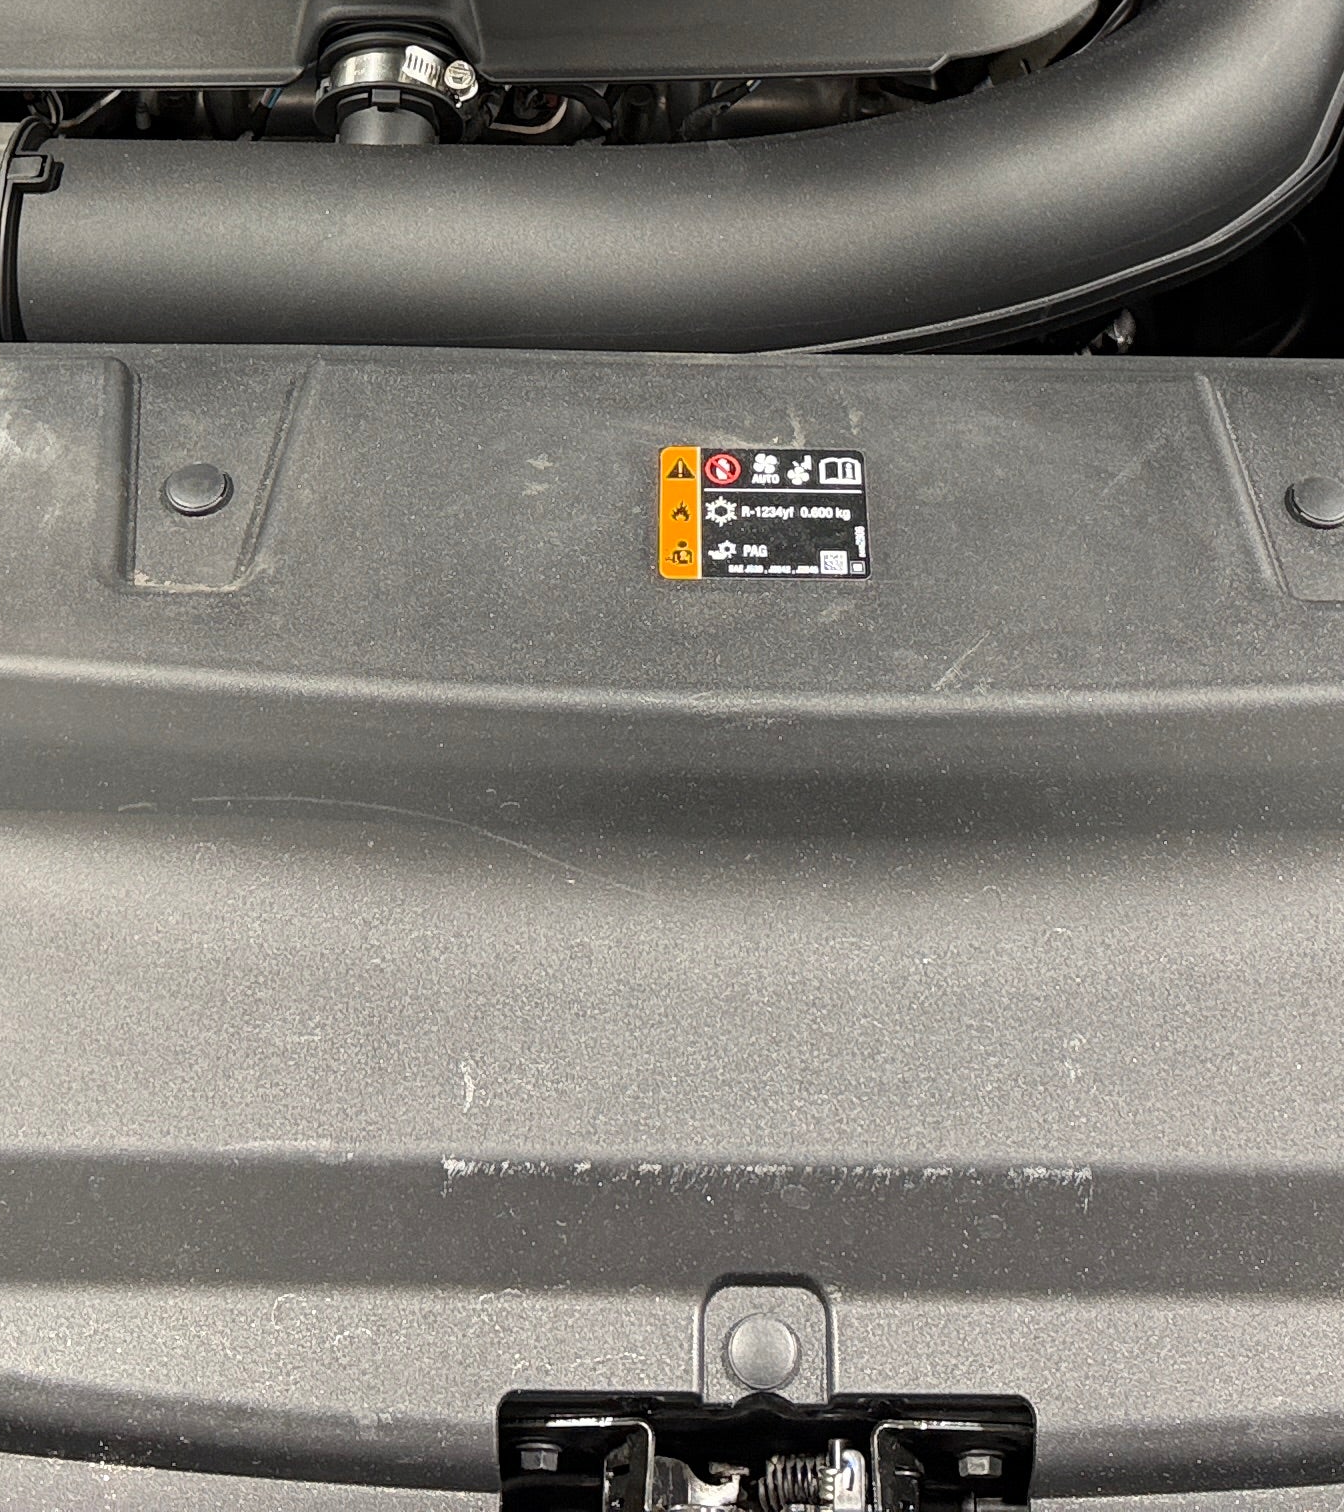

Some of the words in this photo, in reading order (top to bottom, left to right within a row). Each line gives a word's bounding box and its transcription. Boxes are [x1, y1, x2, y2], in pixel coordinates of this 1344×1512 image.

[751, 473, 780, 484] AUTO
[741, 506, 795, 520] R-1234yf
[835, 507, 851, 521] kg
[742, 544, 768, 558] PAG
